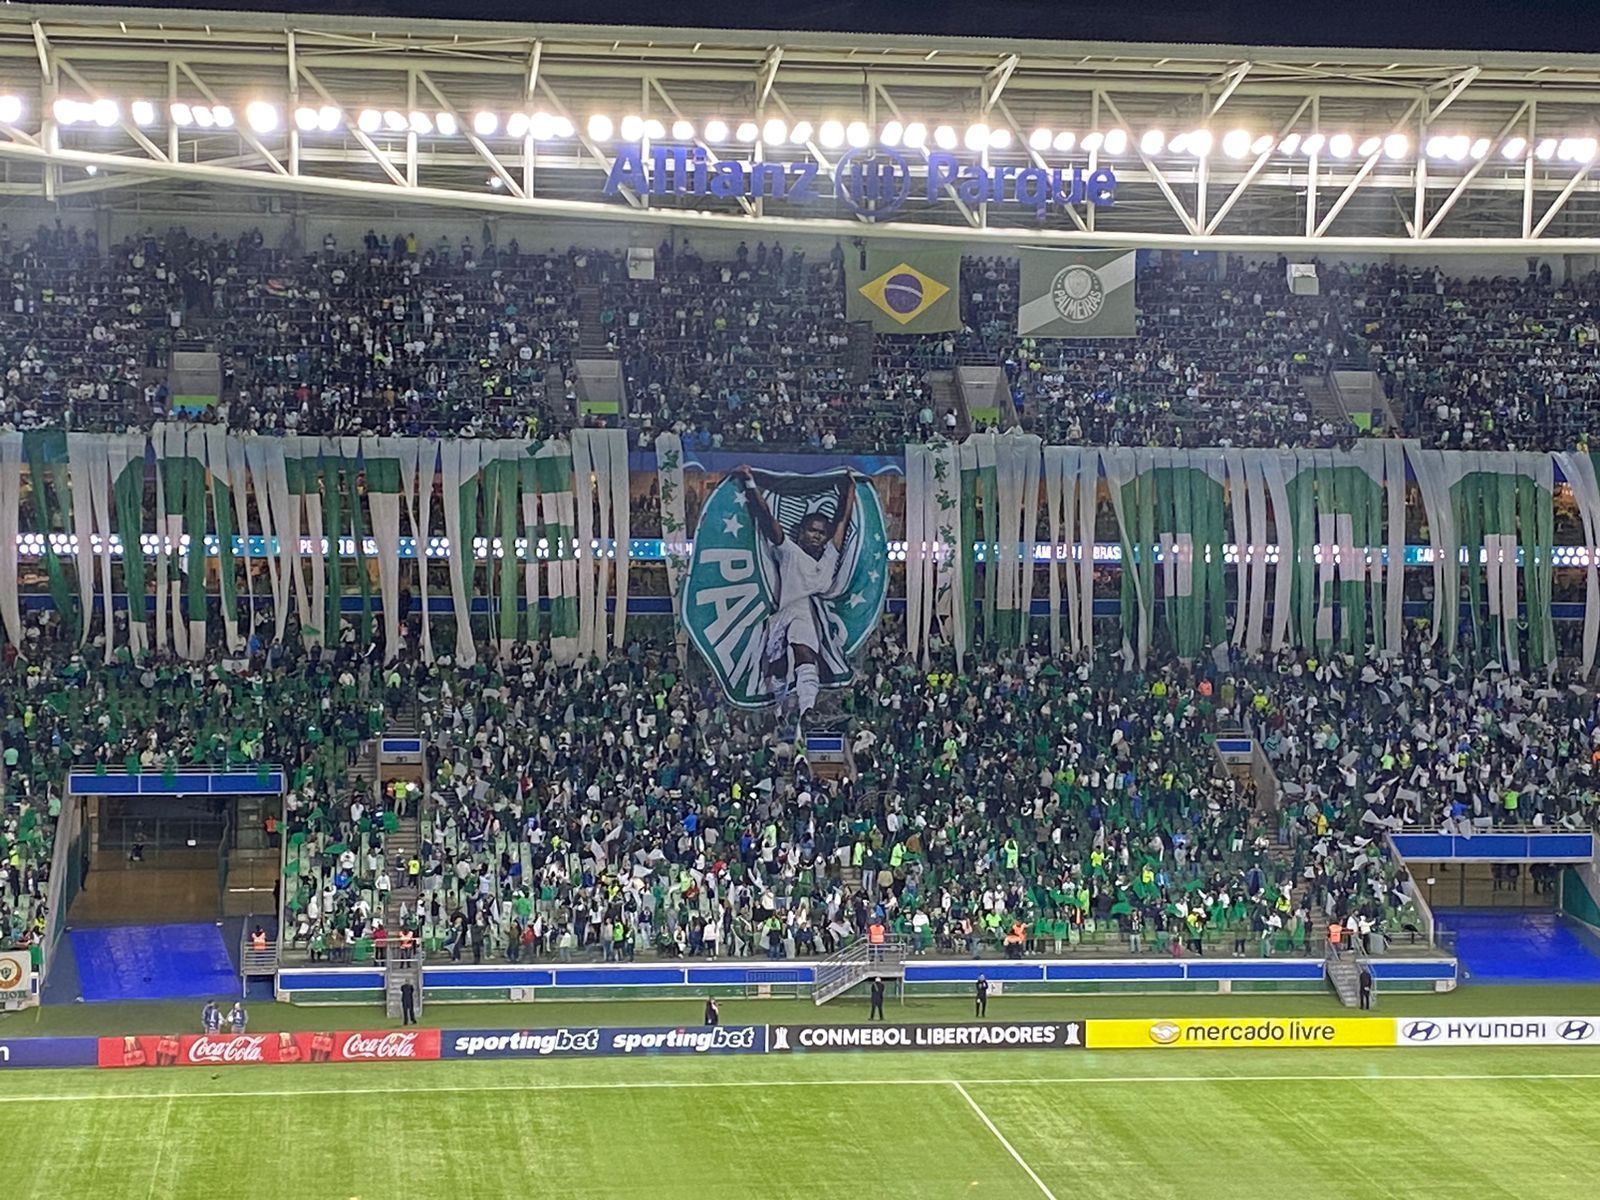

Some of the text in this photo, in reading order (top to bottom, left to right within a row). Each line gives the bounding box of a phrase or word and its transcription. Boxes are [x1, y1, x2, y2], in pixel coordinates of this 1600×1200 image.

[603, 145, 1117, 221] Allianz Parque
[1054, 289, 1101, 320] PALMEIRAS
[455, 1028, 599, 1054] sportingbet
[613, 1026, 755, 1052] sportingbet
[799, 1026, 1056, 1046] CONMEBOL LIBERTADORES
[1186, 1022, 1335, 1041] mercado livre
[1448, 1023, 1546, 1038] HYUNDAI
[188, 1034, 266, 1062] Coca-Cola
[343, 1032, 419, 1059] Coca-Cola
